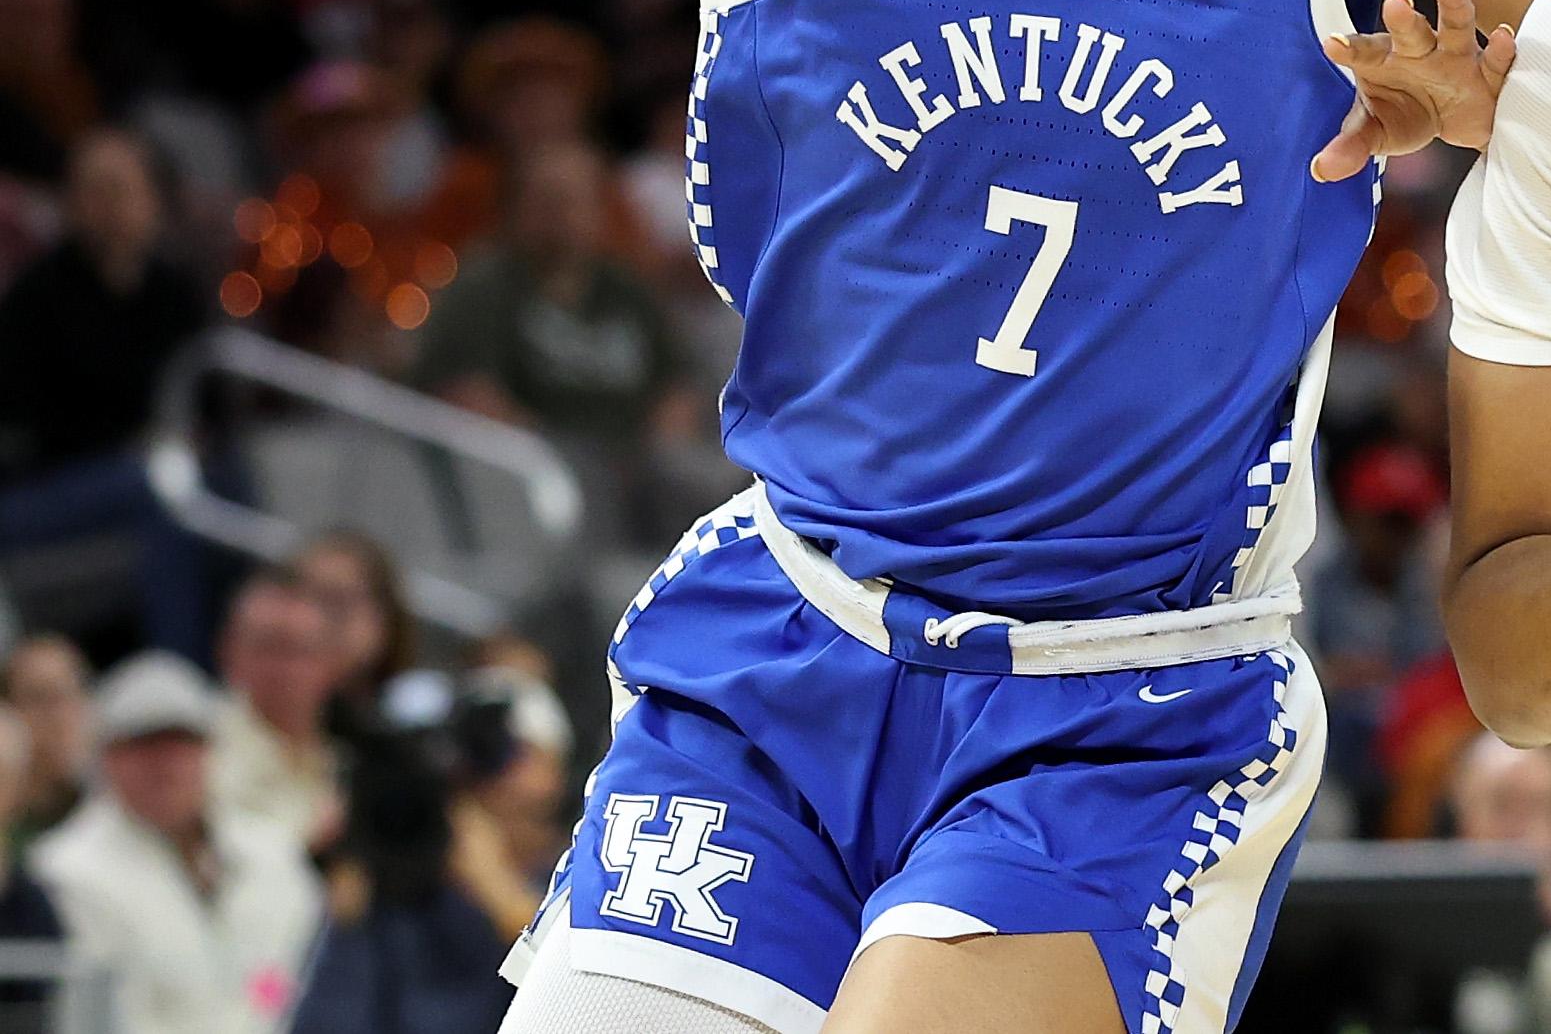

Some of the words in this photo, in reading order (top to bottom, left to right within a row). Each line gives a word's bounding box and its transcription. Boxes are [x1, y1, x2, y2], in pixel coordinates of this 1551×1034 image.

[836, 14, 1242, 214] KENTUCKY
[975, 185, 1079, 377] 7
[599, 792, 756, 946] UK
